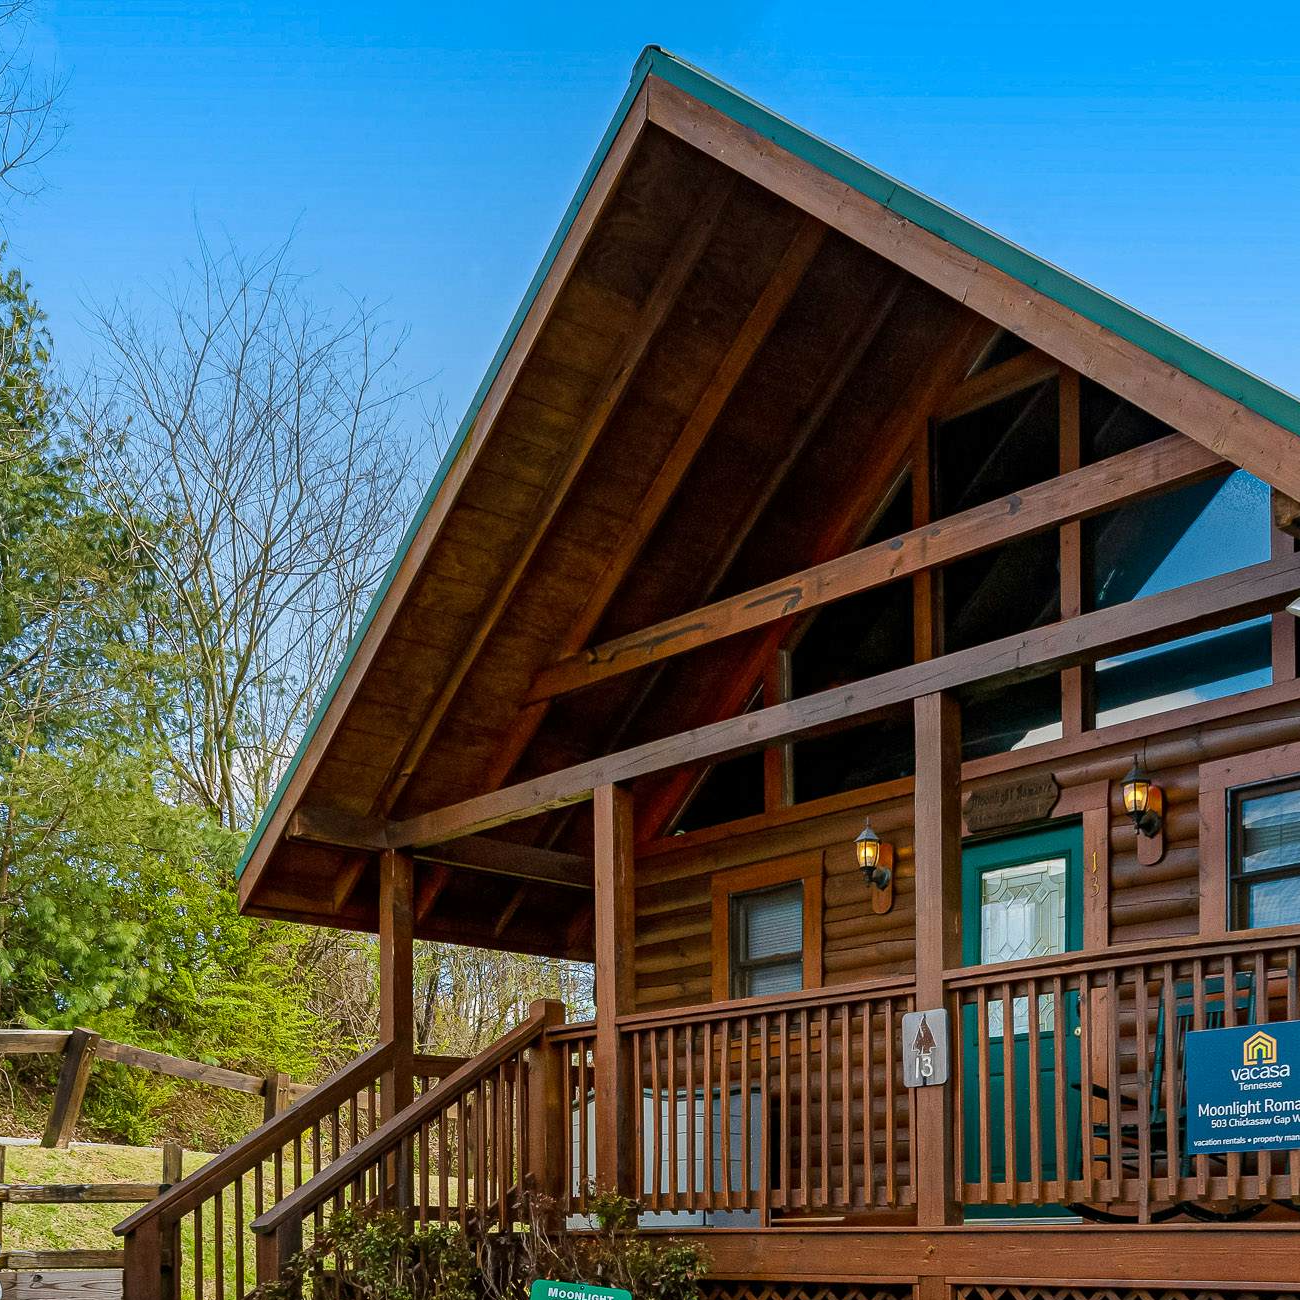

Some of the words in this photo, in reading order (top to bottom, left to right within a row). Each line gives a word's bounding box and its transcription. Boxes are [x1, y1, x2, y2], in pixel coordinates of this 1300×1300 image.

[915, 1056, 933, 1079] 13
[1231, 1064, 1290, 1081] vacasa
[1238, 1081, 1283, 1091] Tennessee
[1198, 1099, 1261, 1118] Moonlight
[1211, 1119, 1227, 1129] 503
[1228, 1117, 1272, 1127] Chickasaw
[1273, 1115, 1291, 1125] Gap
[1193, 1138, 1221, 1147] vacation
[1222, 1137, 1246, 1145] rentals
[1252, 1135, 1283, 1145] property
